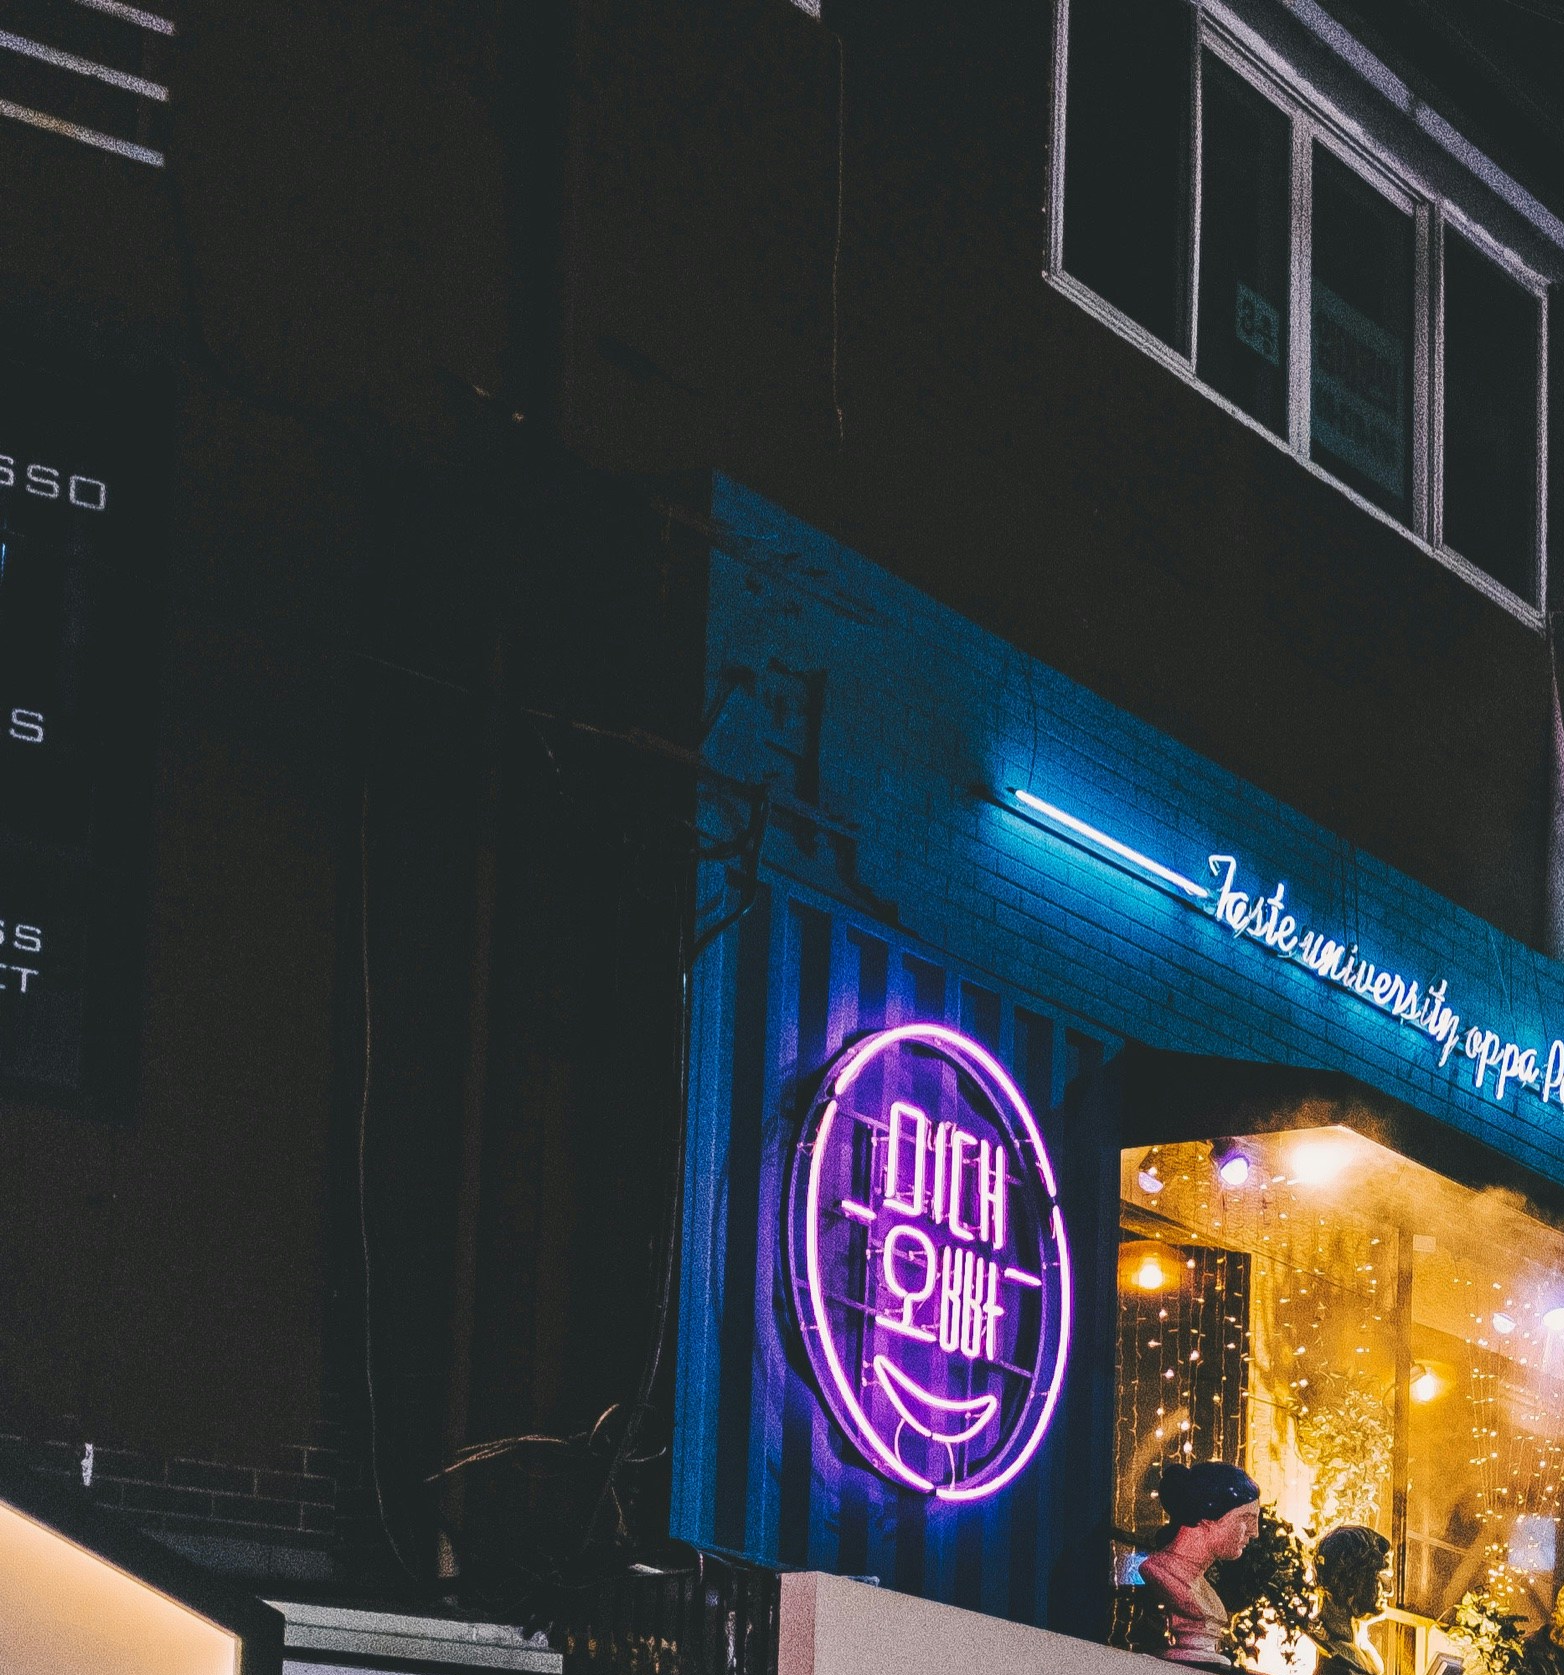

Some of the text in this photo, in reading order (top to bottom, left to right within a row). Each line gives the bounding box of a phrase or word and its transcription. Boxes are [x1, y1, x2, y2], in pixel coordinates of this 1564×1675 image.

[1297, 933, 1460, 1068] university
[1464, 1026, 1540, 1099] oppa
[884, 1100, 1009, 1252] 미대
